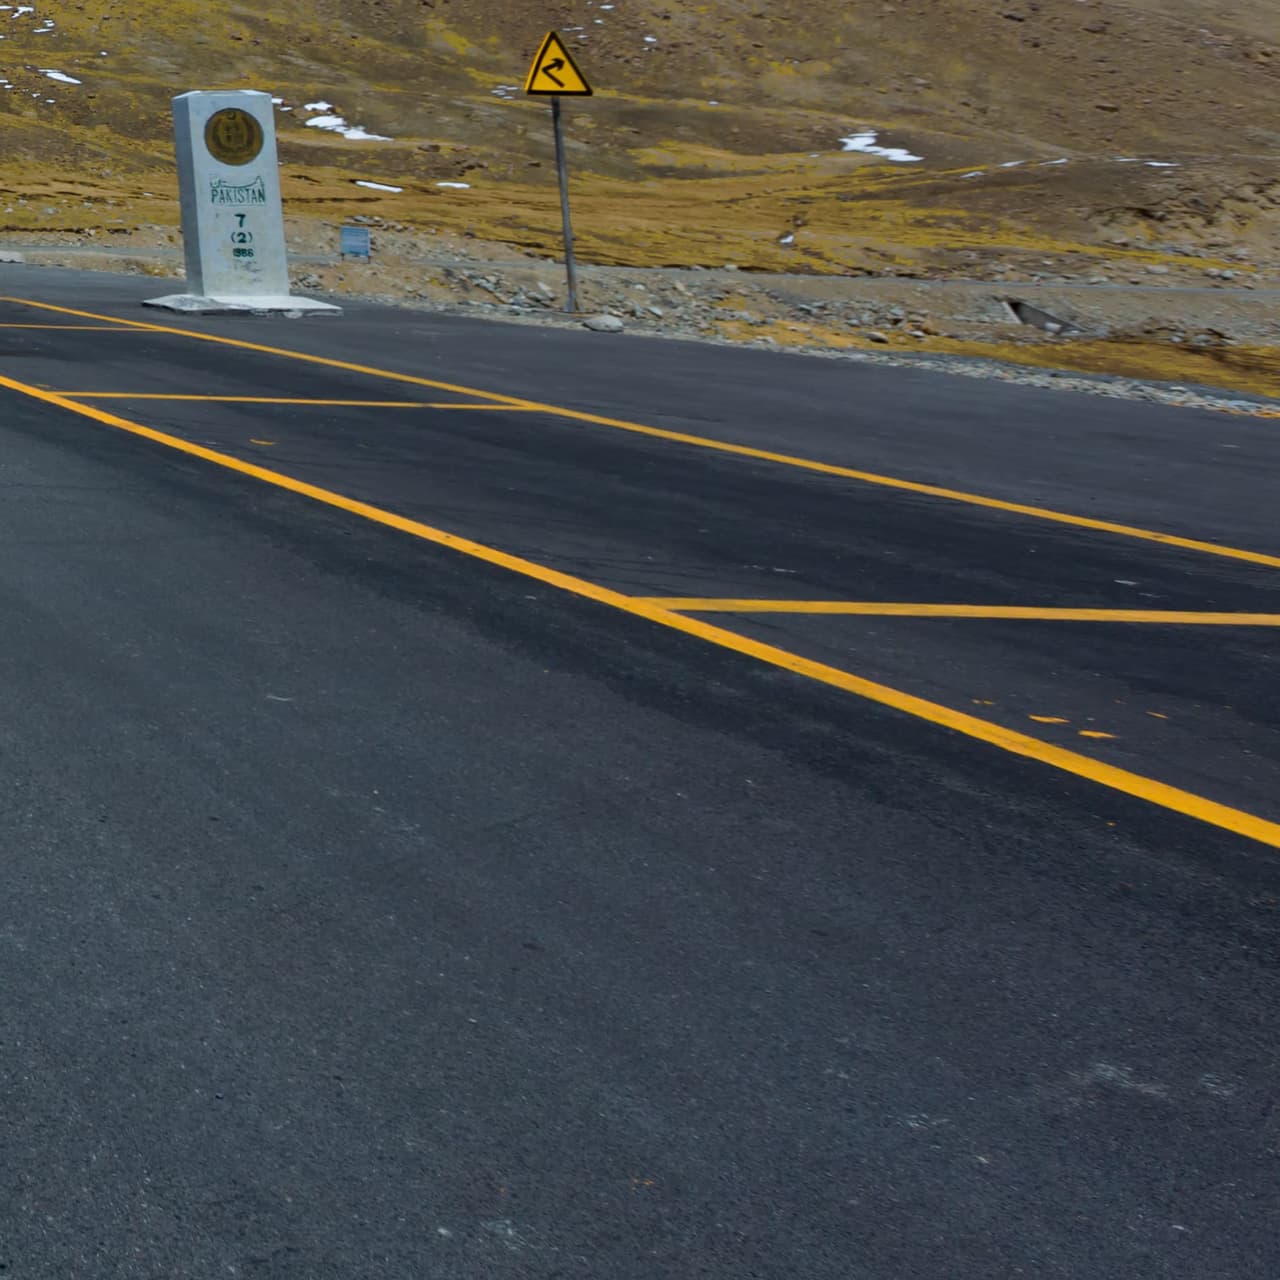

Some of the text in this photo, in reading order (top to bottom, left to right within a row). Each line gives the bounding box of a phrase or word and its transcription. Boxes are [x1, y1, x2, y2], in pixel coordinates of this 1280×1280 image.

[211, 188, 266, 203] PAKISTAN
[234, 213, 246, 228] 7
[231, 231, 253, 243] (2)
